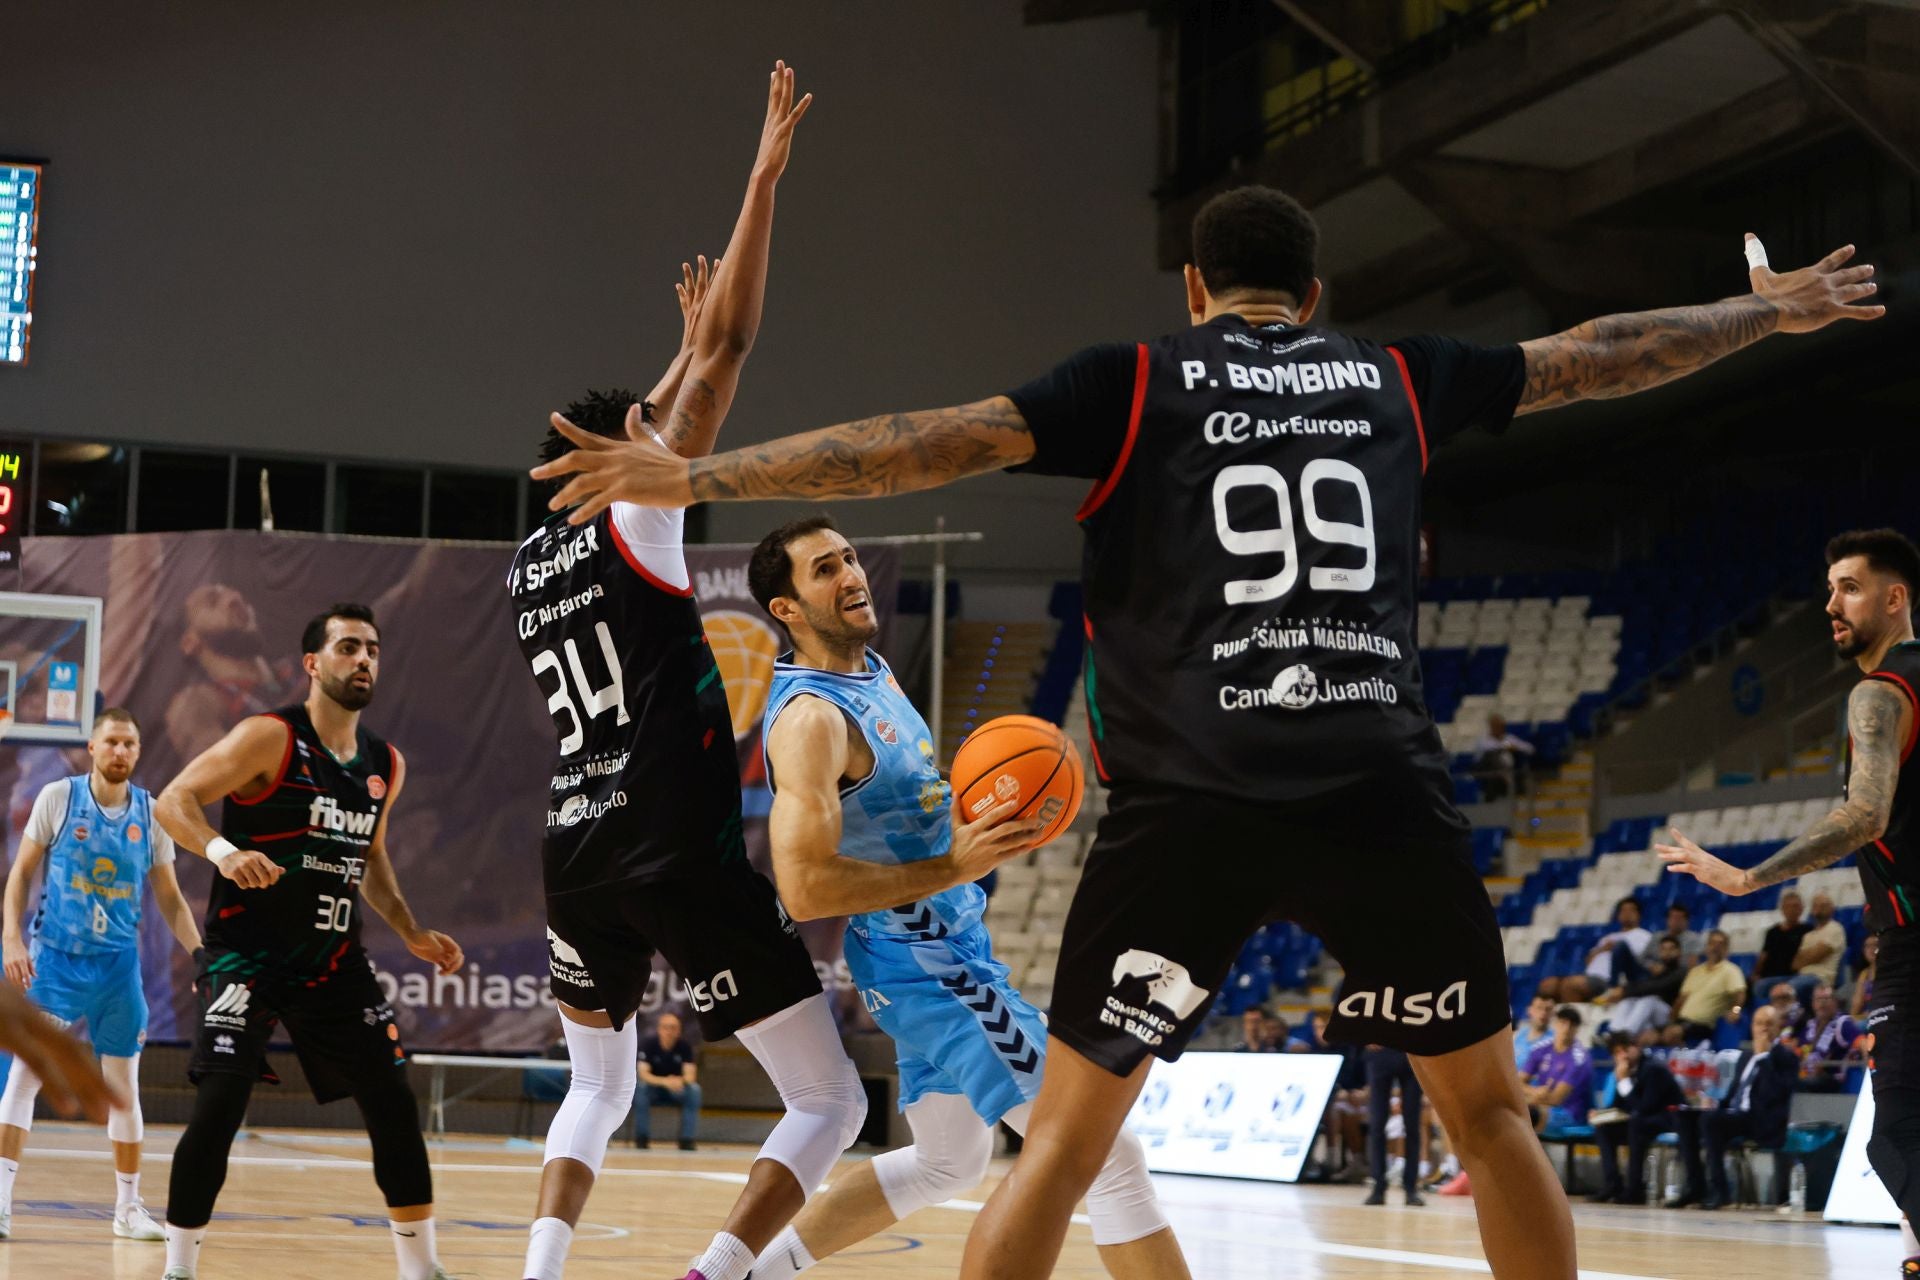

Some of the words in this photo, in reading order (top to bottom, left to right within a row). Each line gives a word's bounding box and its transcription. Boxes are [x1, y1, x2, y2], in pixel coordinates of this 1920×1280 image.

[1182, 360, 1219, 390] P.
[1226, 360, 1381, 395] BOMBINO
[1255, 415, 1372, 438] AirEuropa
[1212, 458, 1376, 605] 99
[1213, 637, 1250, 661] PUIG
[1258, 628, 1309, 649] SANTA
[1313, 626, 1402, 660] MAGDALENA
[531, 620, 631, 757] 34
[1318, 676, 1398, 705] Juanito
[309, 795, 378, 836] fibwi
[314, 894, 353, 933] 30
[1099, 1008, 1121, 1028] EN
[1338, 980, 1467, 1025] alsa
